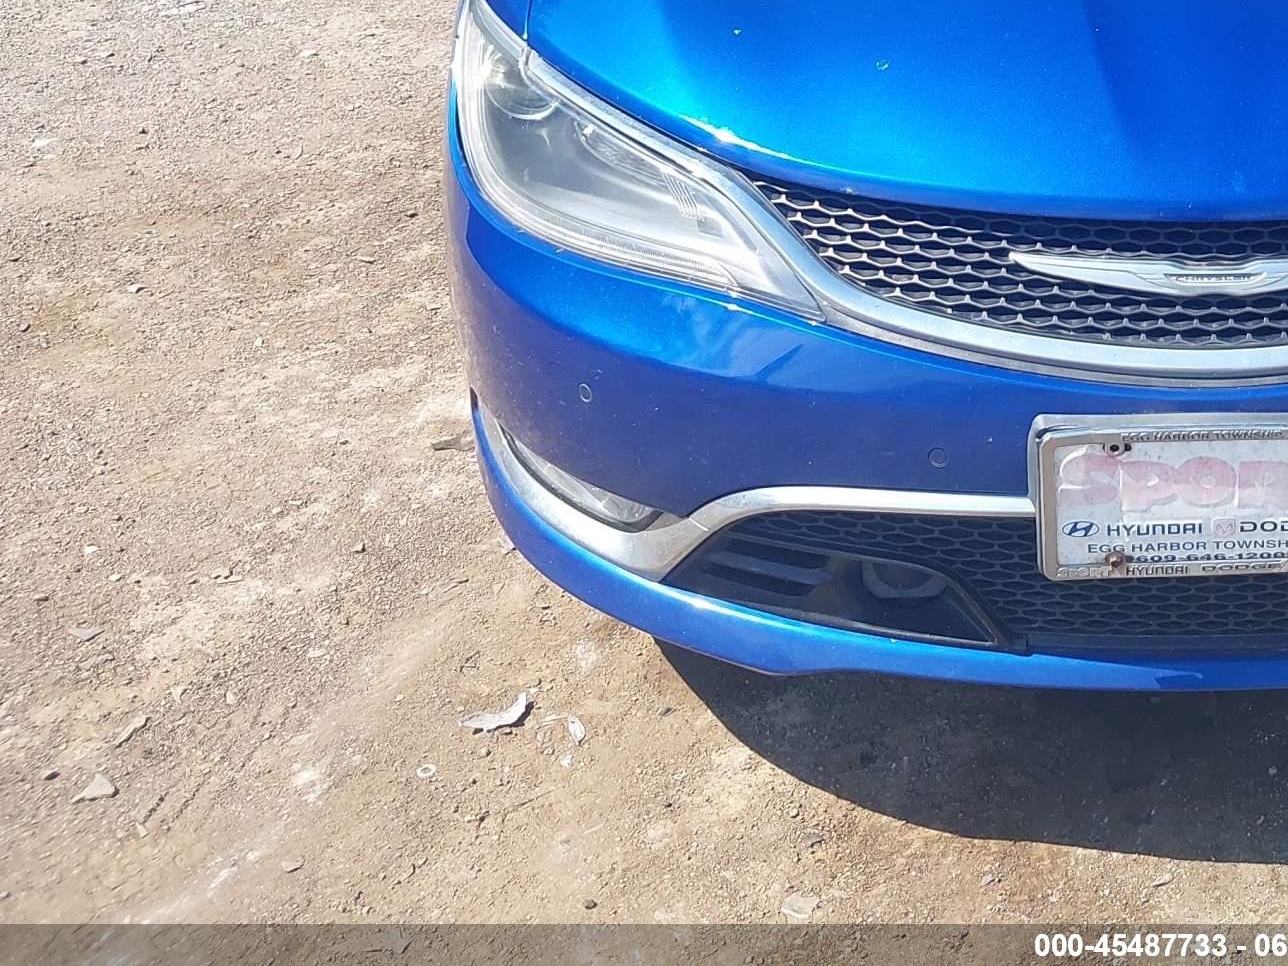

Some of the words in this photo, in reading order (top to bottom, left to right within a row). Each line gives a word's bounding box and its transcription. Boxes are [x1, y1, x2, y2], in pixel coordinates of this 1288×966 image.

[1173, 274, 1251, 282] CHRYSLER
[1121, 433, 1149, 443] EGG
[1154, 432, 1210, 442] HARBOR
[1214, 430, 1282, 441] TOWNSHIP
[1107, 523, 1203, 537] HYUNDAI
[1087, 543, 1126, 554] EGG
[1131, 541, 1207, 553] HARBOR
[1135, 551, 1286, 564] 609-646-1200
[1057, 566, 1112, 579] SPORT
[1126, 565, 1189, 577] HYUNDAI
[1201, 562, 1282, 572] DODGE
